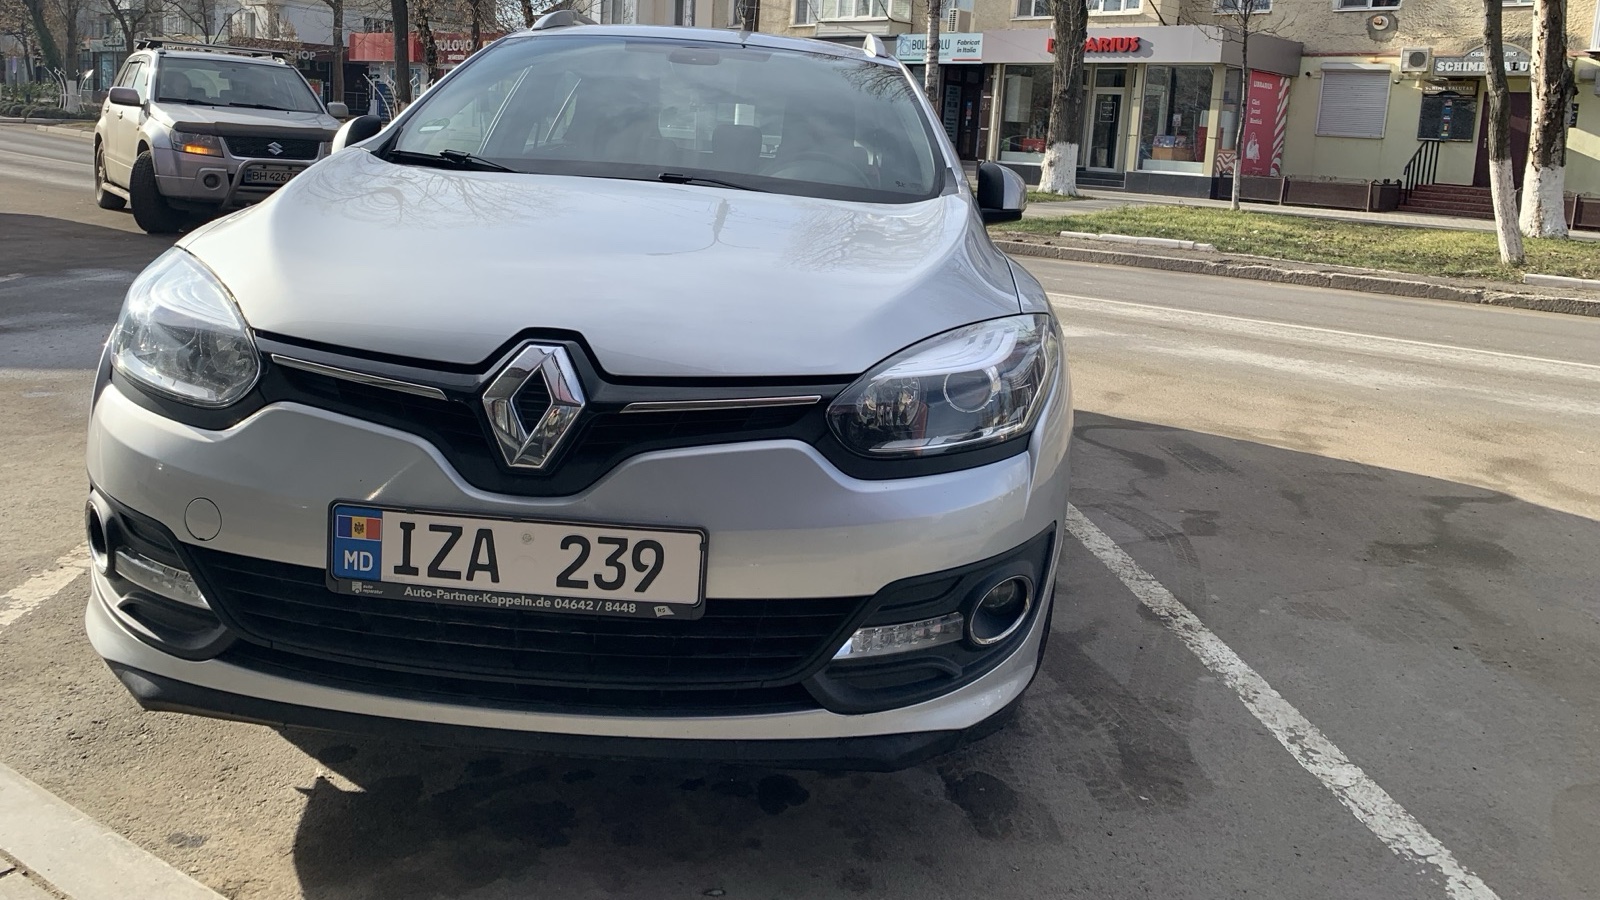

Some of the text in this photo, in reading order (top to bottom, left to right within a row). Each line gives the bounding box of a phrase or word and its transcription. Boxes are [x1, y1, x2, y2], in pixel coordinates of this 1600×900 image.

[252, 171, 267, 181] BH
[269, 172, 293, 182] 4267
[344, 550, 374, 572] MD
[393, 521, 665, 593] IZA 239
[404, 586, 636, 613] Auto-Partner-Kappeln.de 04642 / 8448
